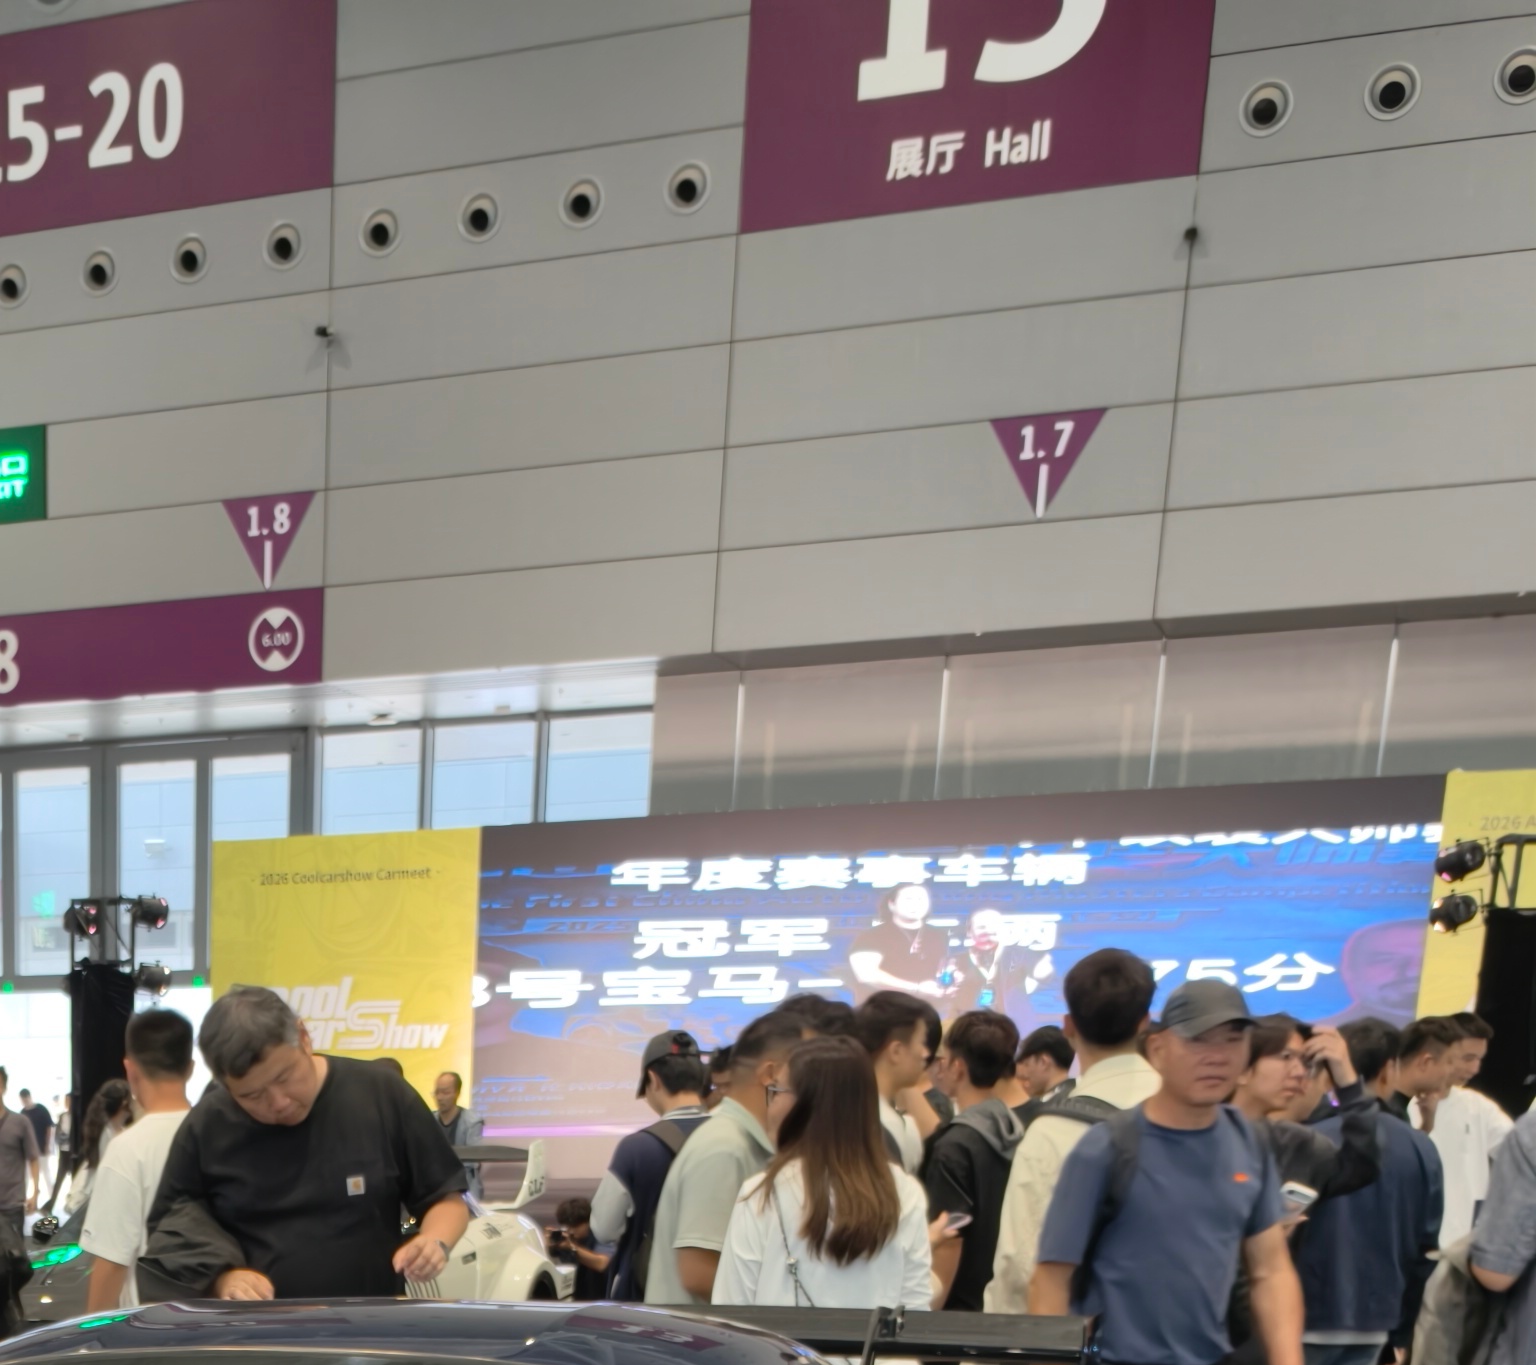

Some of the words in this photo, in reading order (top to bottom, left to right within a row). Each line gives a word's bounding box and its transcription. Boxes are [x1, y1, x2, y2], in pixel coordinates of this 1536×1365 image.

[886, 131, 965, 181] 展厅
[985, 118, 1052, 168] Hall
[1019, 420, 1075, 460] 1.7
[246, 502, 291, 537] 1.8
[611, 855, 1091, 891] 年度赛事车辆
[632, 918, 831, 959] 冠军
[337, 1000, 449, 1050] Show
